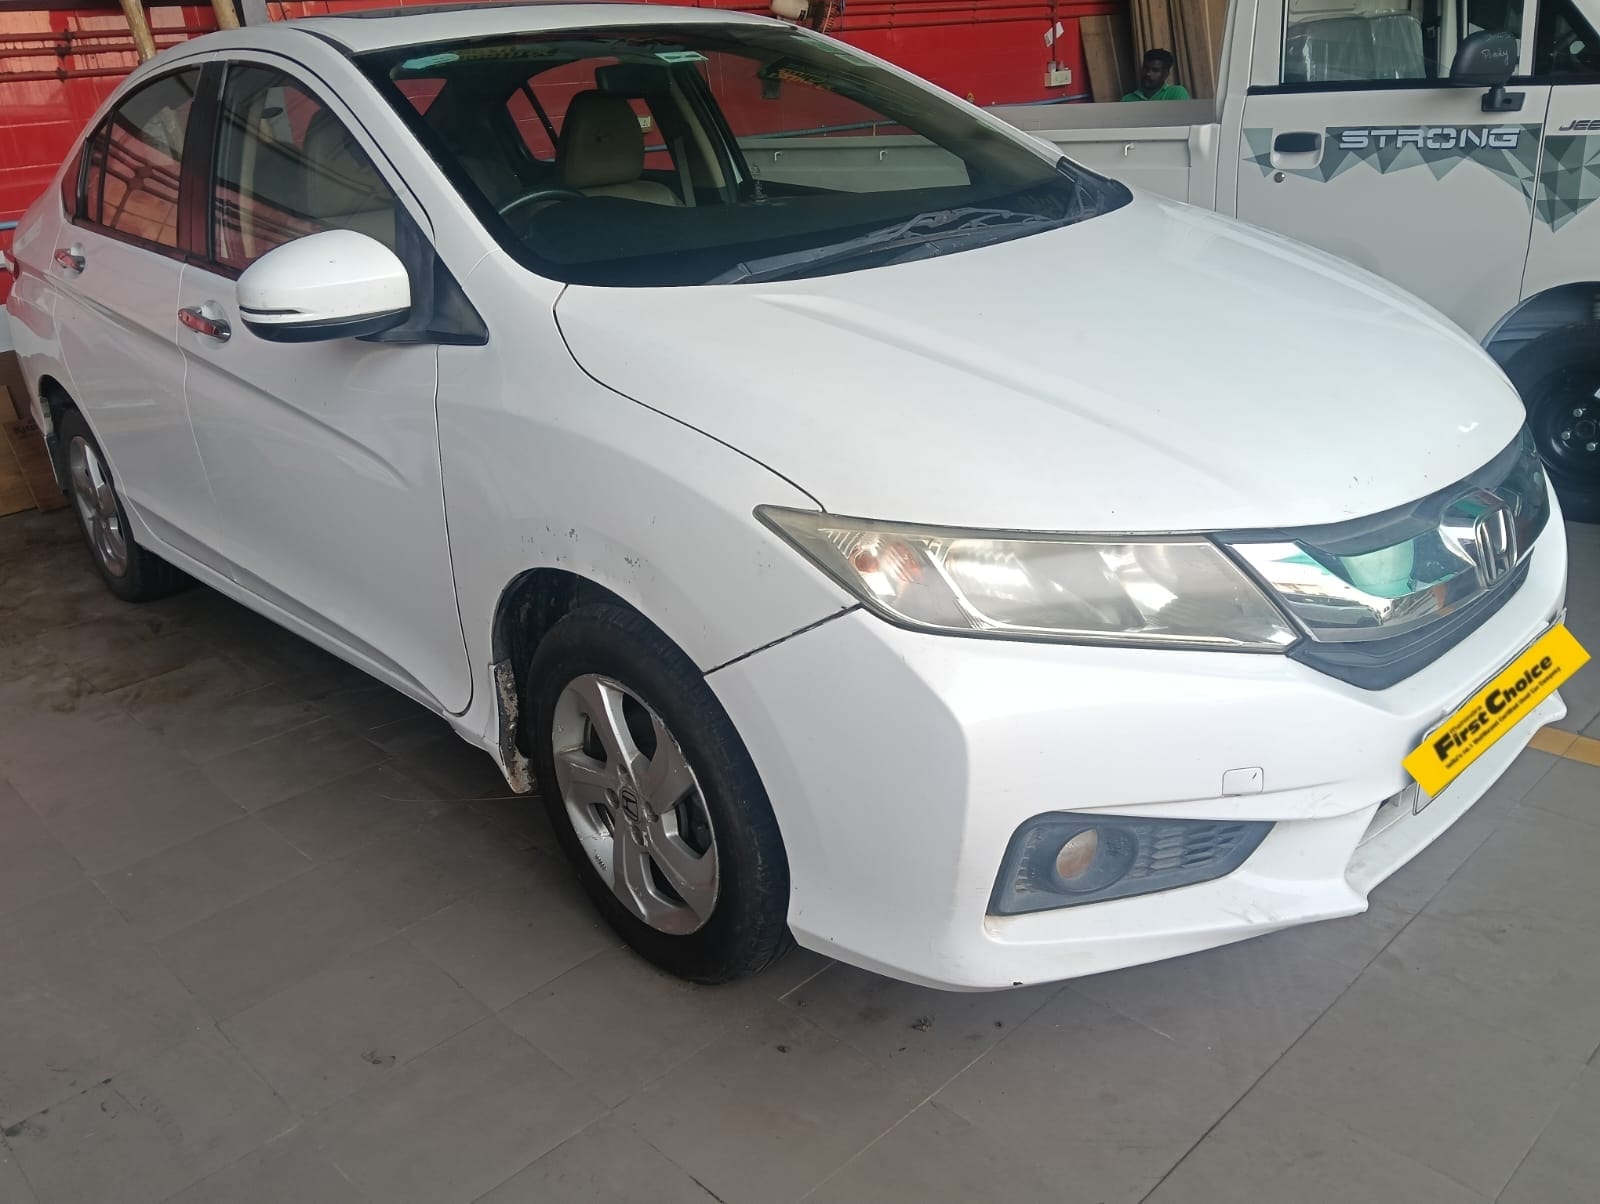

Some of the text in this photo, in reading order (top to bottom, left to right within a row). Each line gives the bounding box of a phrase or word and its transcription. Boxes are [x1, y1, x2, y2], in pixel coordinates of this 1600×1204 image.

[1339, 128, 1521, 150] STRONG
[1433, 656, 1553, 762] First Choice
